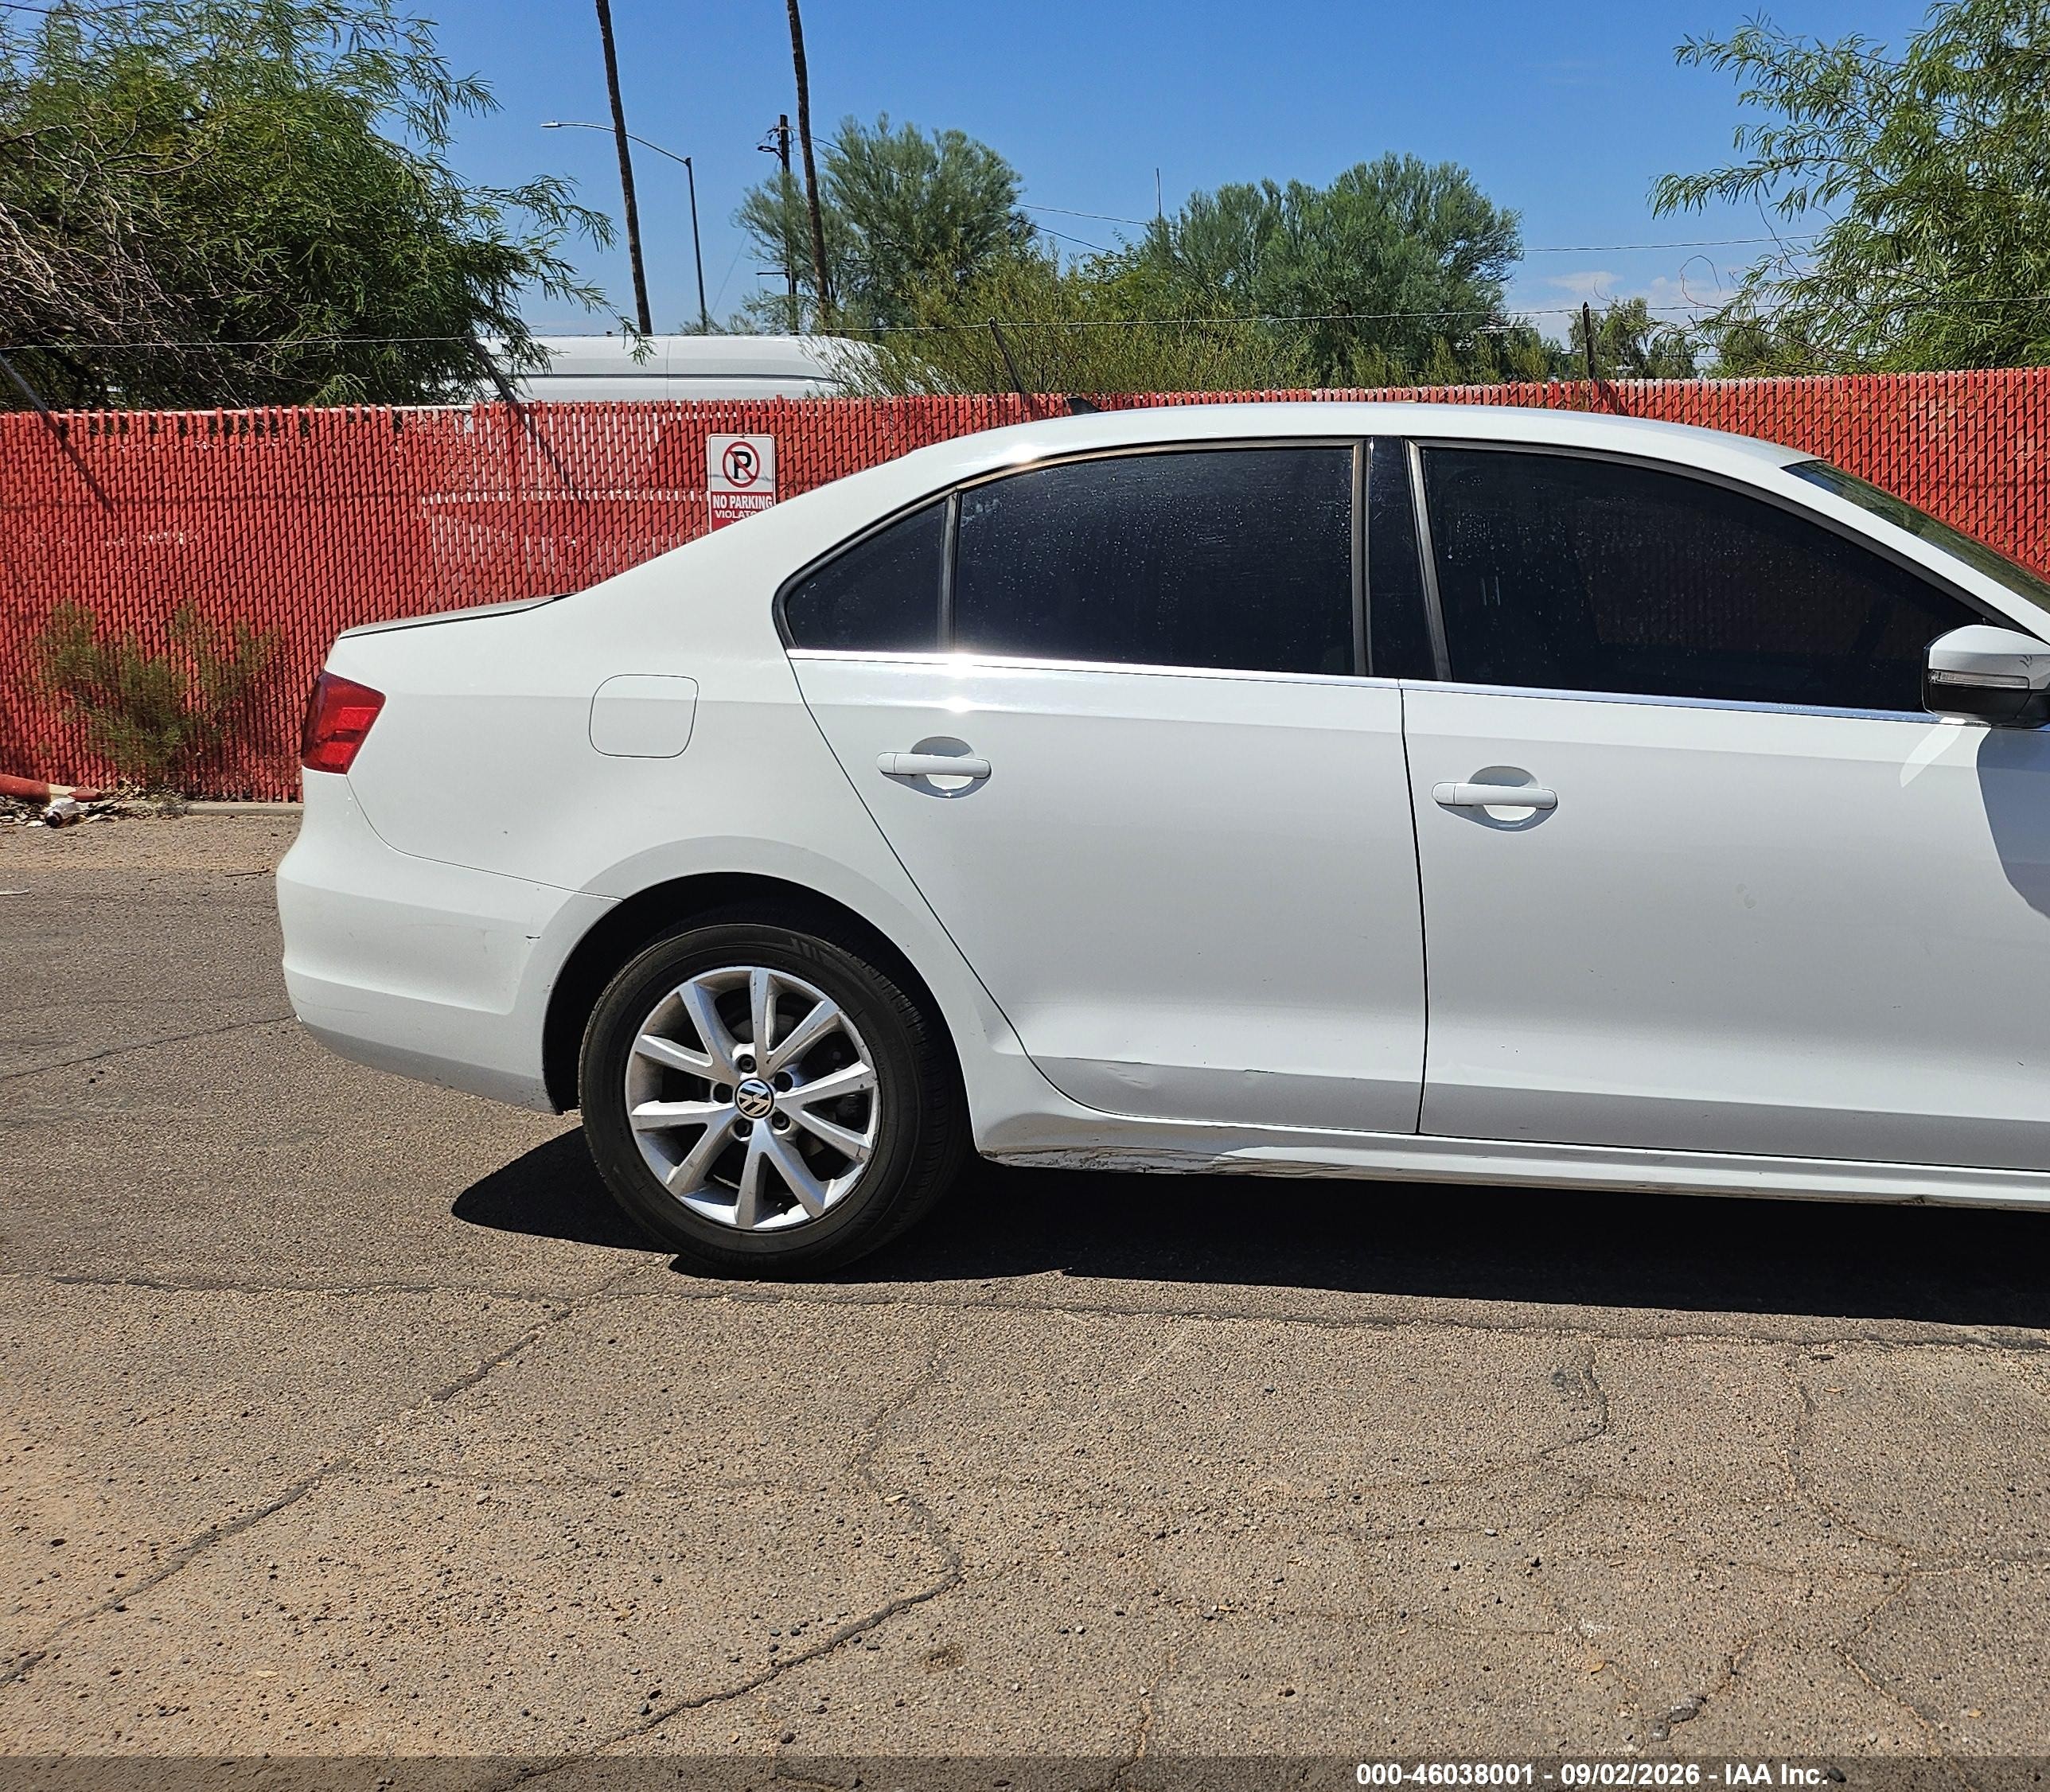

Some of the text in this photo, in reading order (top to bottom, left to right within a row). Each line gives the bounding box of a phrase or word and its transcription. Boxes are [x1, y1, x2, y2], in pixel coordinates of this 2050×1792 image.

[732, 450, 752, 480] P
[712, 494, 773, 510] NO PARKING
